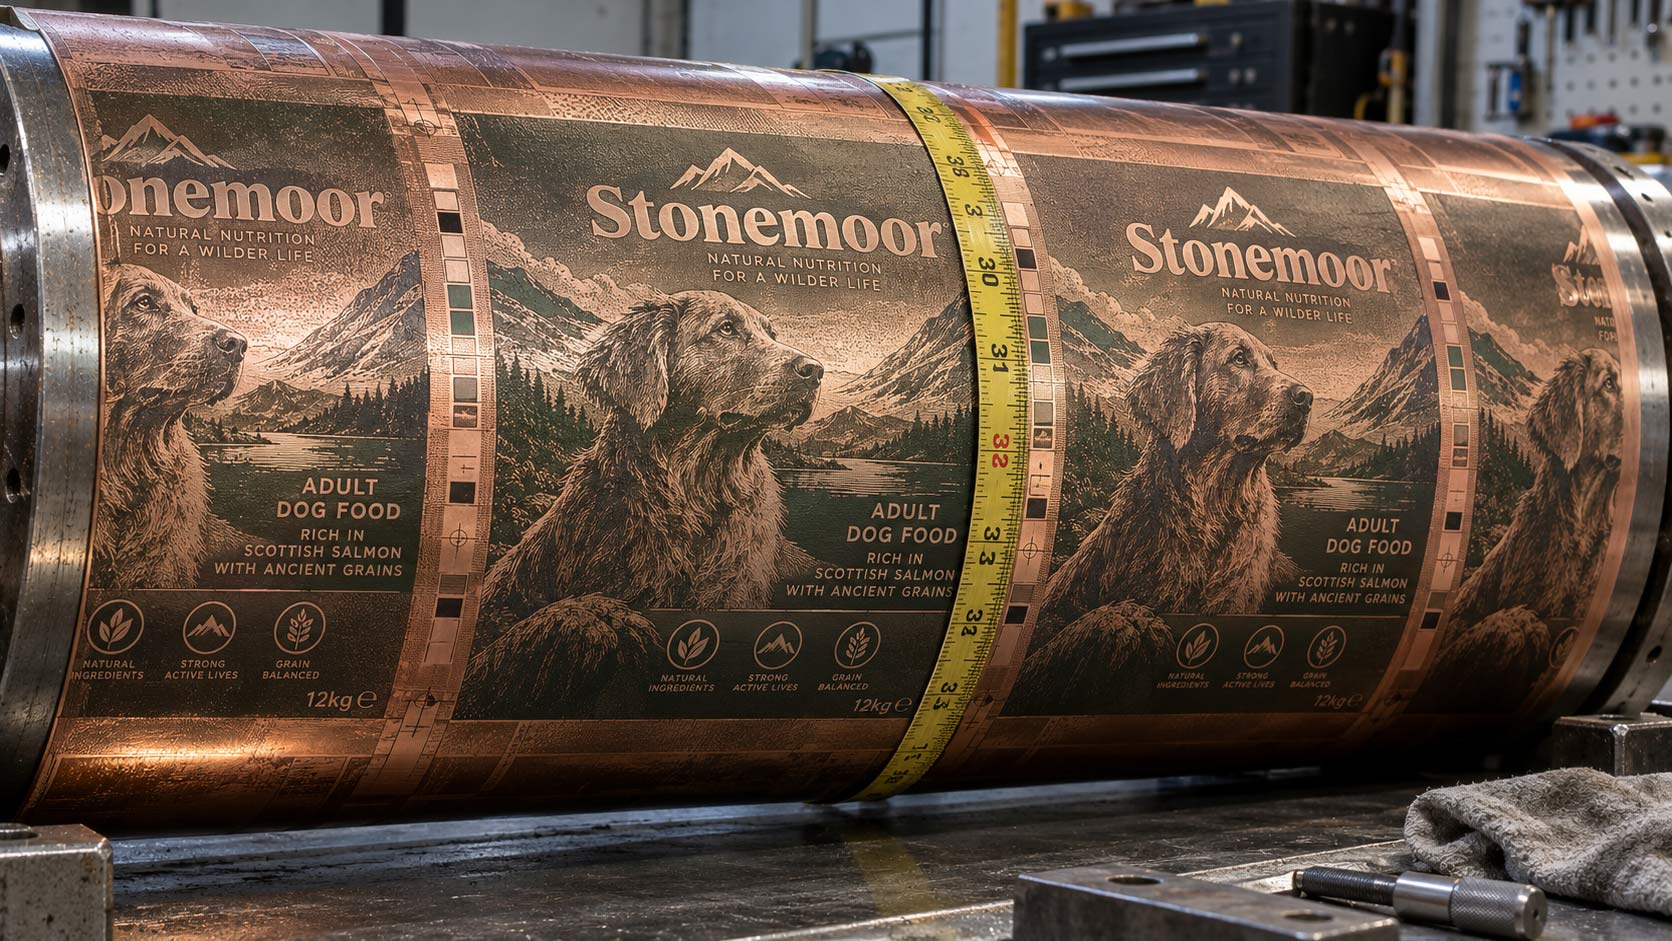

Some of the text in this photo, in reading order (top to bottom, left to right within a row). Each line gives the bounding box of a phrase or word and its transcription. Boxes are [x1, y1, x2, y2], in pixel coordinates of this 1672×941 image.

[586, 184, 943, 259] Stonemoor
[130, 225, 315, 246] NATURAL NUTRITION
[134, 243, 313, 263] FOR A WILDER LIFE
[1125, 222, 1392, 293] Stonemoor
[707, 252, 882, 274] NATURAL NUTRITION
[978, 256, 999, 287] 30
[713, 269, 881, 291] FOR A WILDER LIFE
[1221, 287, 1351, 308] NATURAL NUTRITION
[1227, 303, 1352, 324] FOR A WILDER LIFE
[991, 343, 1009, 373] 31
[992, 433, 1010, 468] 32
[302, 477, 378, 495] ADULT
[276, 501, 400, 520] DOG FOOD
[871, 503, 941, 521] ADULT
[1346, 518, 1400, 534] ADULT
[301, 528, 364, 541] RICH IN
[846, 525, 958, 545] DOG FOOD
[244, 544, 402, 559] SCOTTISH SALMON
[979, 526, 1000, 565] 33
[1326, 538, 1412, 555] DOG FOOD
[867, 552, 923, 565] RICH IN
[214, 562, 403, 577] WITH ANCIENT GRAINS
[815, 568, 956, 582] SCOTTISH SALMON
[1340, 562, 1385, 574] RICH IN
[1298, 576, 1408, 589] SCOTTISH SALMON
[786, 584, 953, 598] WITH ANCIENT GRAINS
[1275, 591, 1406, 605] WITH ANCIENT GRAINS
[83, 659, 135, 669] NATURAL
[180, 659, 225, 669] STRONG
[275, 659, 310, 669] GRAIN
[71, 671, 144, 680] INGREDIENTS
[164, 671, 239, 680] ACTIVE LIVES
[262, 671, 320, 680] BALANCED
[660, 674, 708, 682] NATURAL
[748, 673, 789, 682] STRONG
[831, 673, 862, 682] GRAIN
[648, 683, 715, 692] INGREDIENTS
[732, 683, 798, 692] ACTIVE LIVES
[817, 682, 869, 691] BALANCED
[306, 691, 353, 711] 12kg
[853, 698, 892, 714] 12kg
